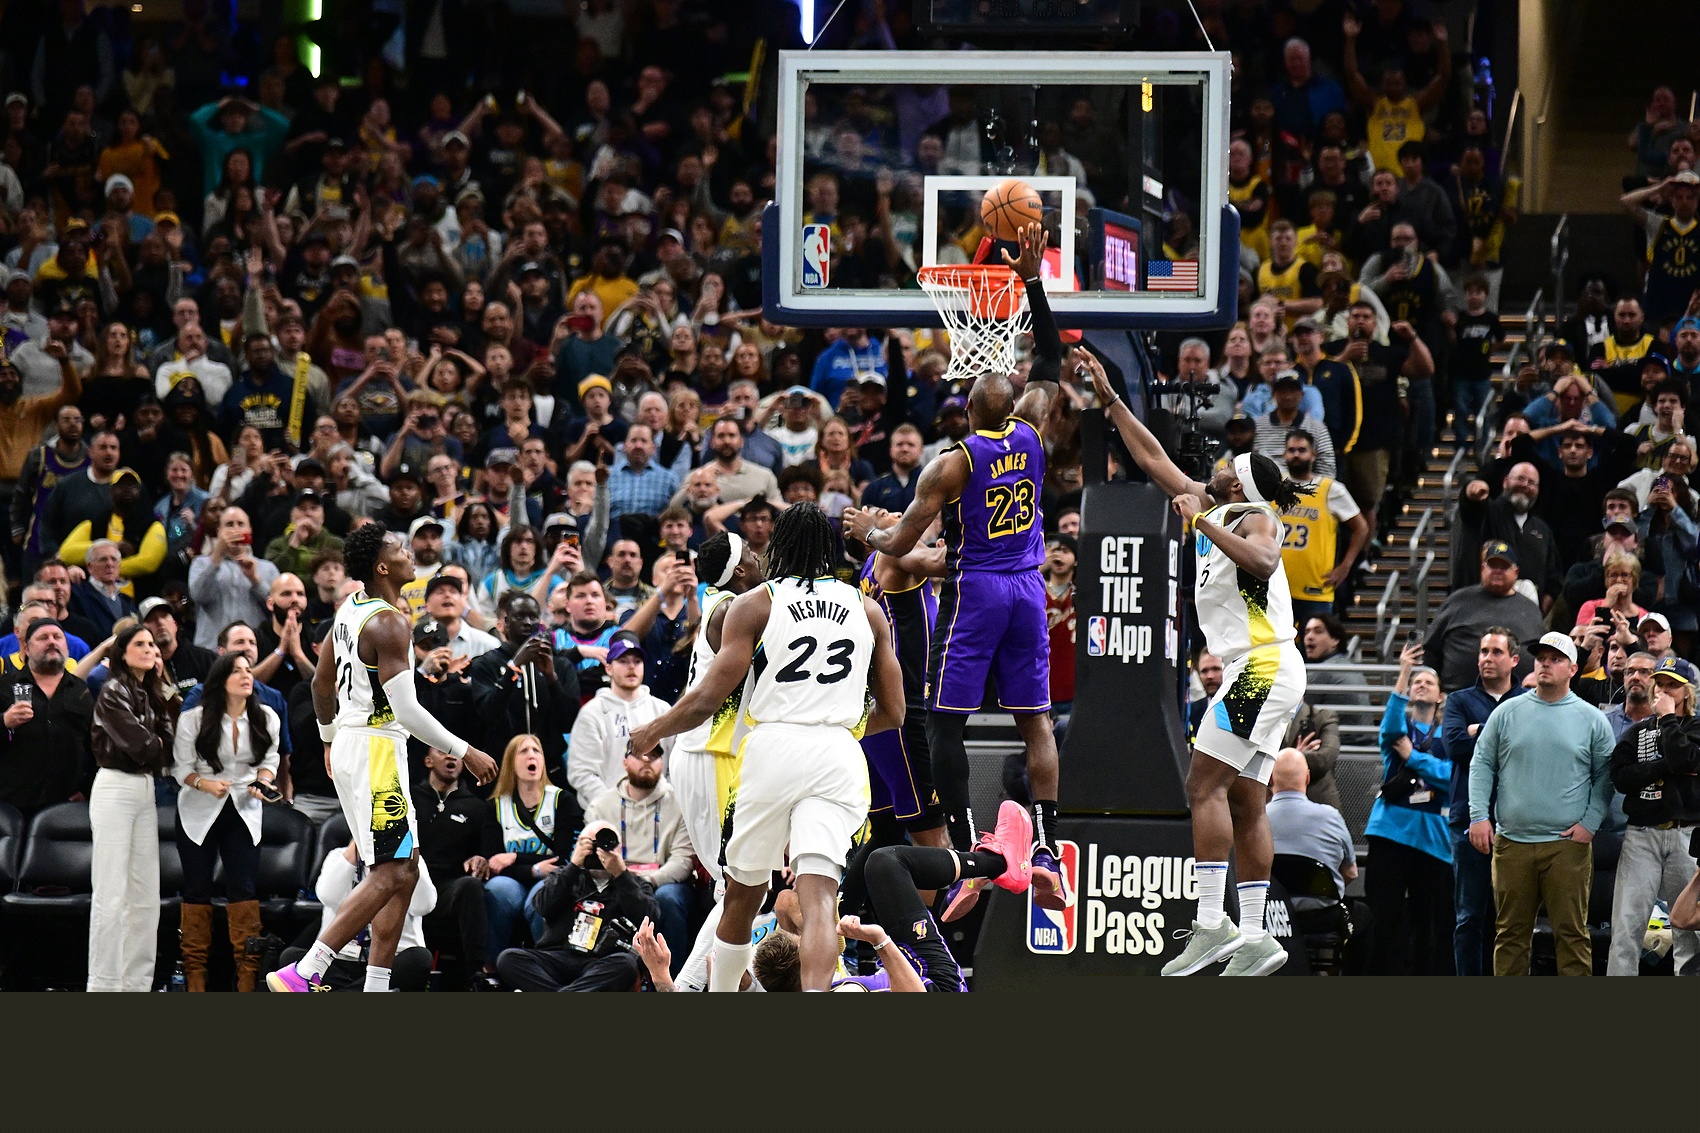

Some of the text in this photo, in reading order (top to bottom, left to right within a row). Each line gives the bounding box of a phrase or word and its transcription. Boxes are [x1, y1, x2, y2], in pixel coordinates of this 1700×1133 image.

[804, 272, 819, 285] NBA
[989, 452, 1028, 480] JAMES
[985, 478, 1036, 540] 23
[1100, 535, 1144, 574] GET
[787, 599, 850, 627] NESMITH
[1099, 576, 1144, 614] THE
[1107, 616, 1153, 664] App
[774, 635, 856, 685] 23
[1087, 843, 1201, 910] League
[1033, 927, 1059, 947] NBA
[1085, 899, 1166, 956] Pass
